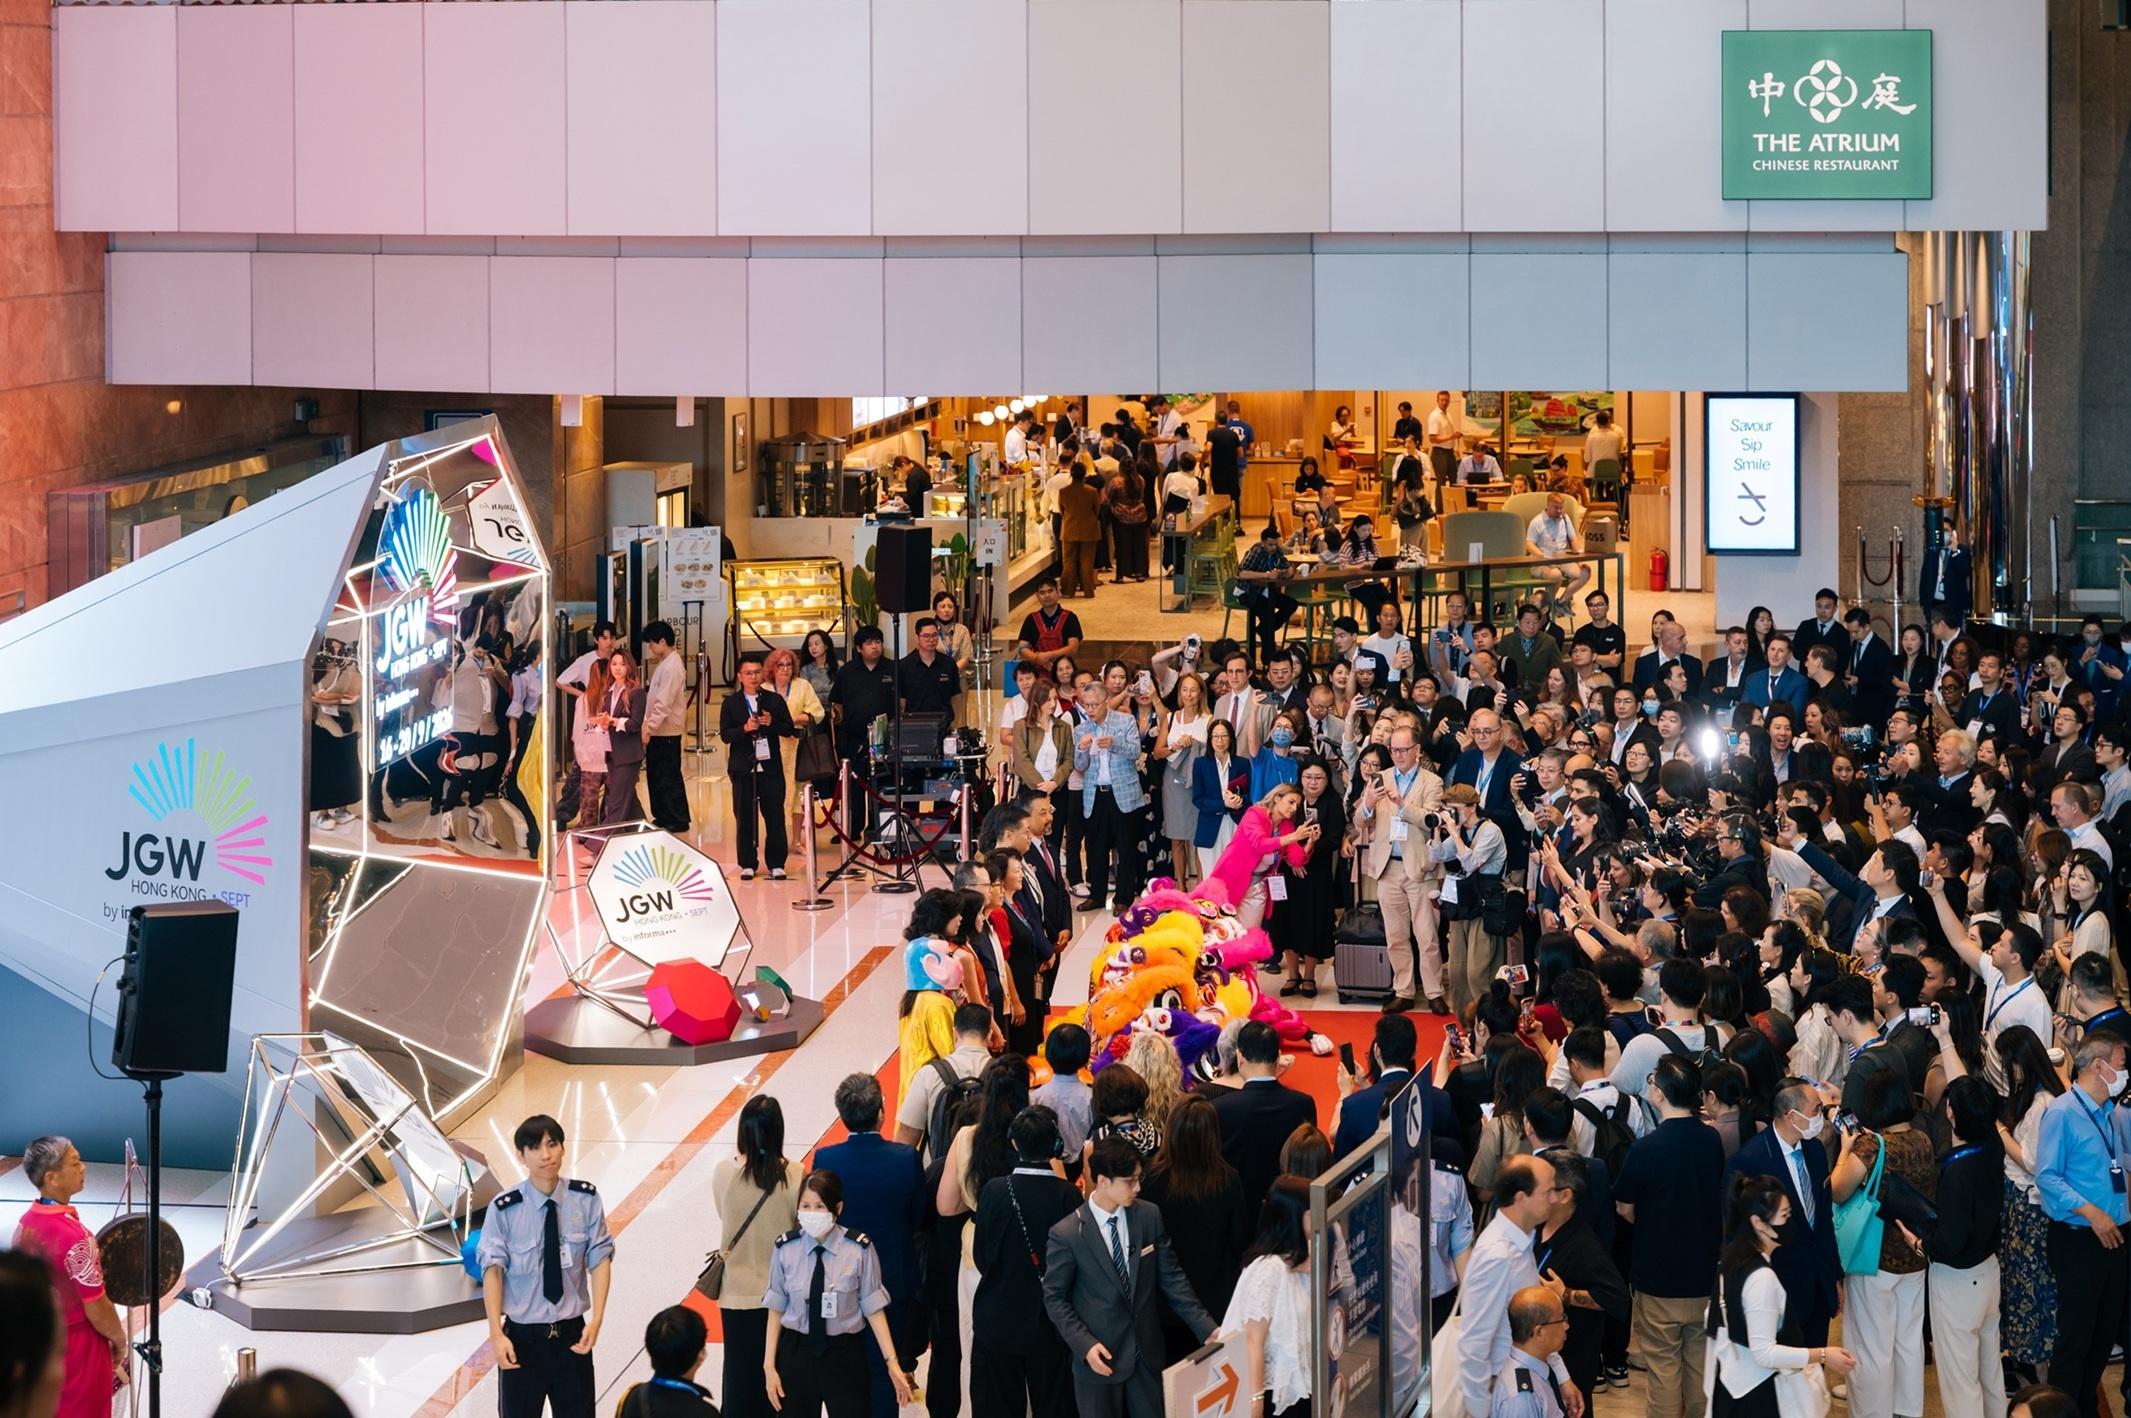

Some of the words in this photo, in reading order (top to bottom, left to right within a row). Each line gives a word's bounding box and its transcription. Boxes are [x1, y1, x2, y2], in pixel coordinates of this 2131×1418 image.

[1748, 72, 1786, 118] 中
[1861, 72, 1917, 115] 庭
[1753, 133, 1801, 152] THE
[1808, 133, 1900, 152] ATRIUM
[1752, 159, 1810, 171] CHINESE
[1814, 159, 1899, 171] RESTAURANT
[1730, 418, 1773, 432] Savour
[1740, 438, 1763, 453] Sip
[1733, 457, 1771, 471] Smile
[661, 616, 700, 627] RBOUR
[376, 596, 428, 673] JGW
[104, 831, 206, 882] JGW
[131, 879, 168, 898] HONG
[170, 884, 207, 901] KONG
[221, 890, 251, 908] SEPT
[103, 902, 118, 922] by
[616, 890, 673, 922] JGW
[634, 916, 659, 925] HONG
[660, 912, 683, 921] KONG
[689, 906, 709, 917] SEPT
